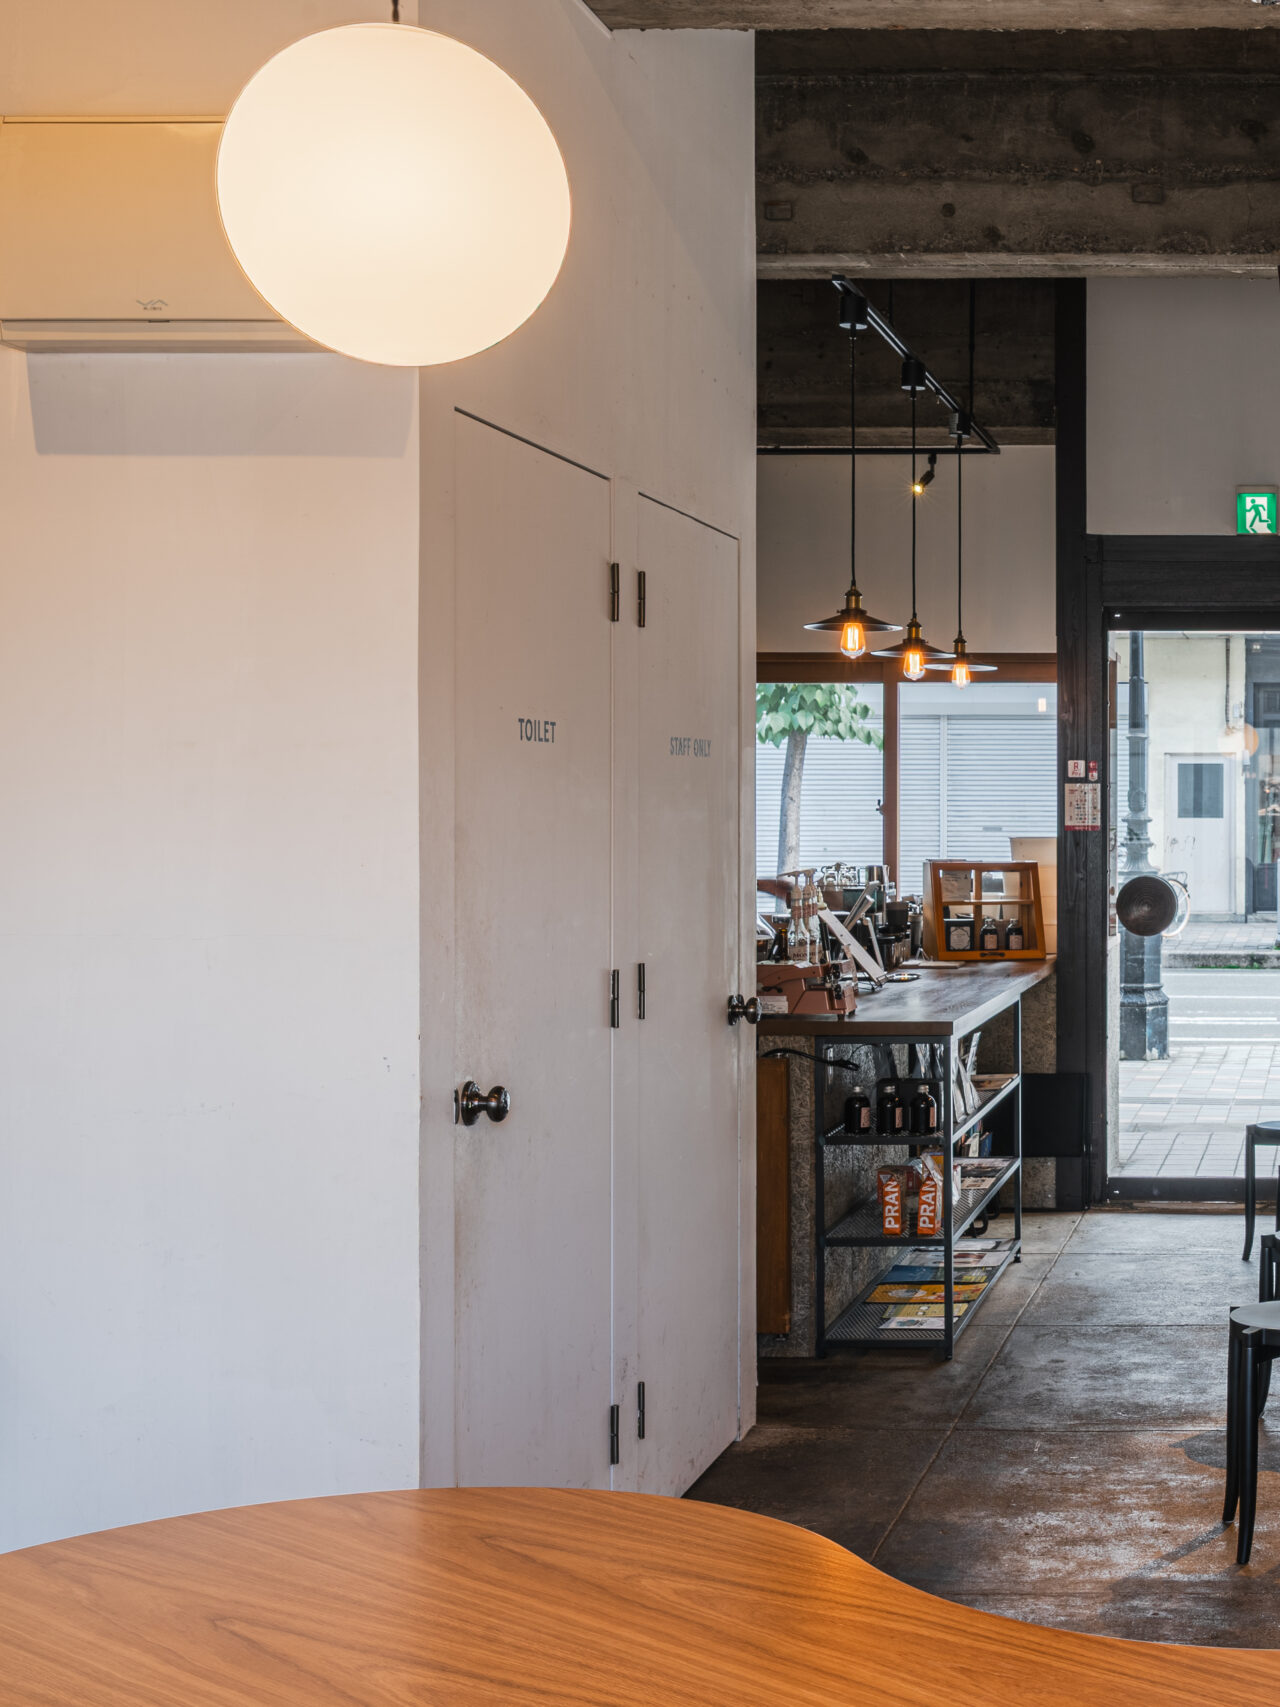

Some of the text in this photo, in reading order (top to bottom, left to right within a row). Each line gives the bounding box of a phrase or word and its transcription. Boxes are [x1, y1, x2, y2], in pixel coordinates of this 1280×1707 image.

[518, 718, 556, 743] TOILET
[670, 736, 712, 758] STAFF ONLY
